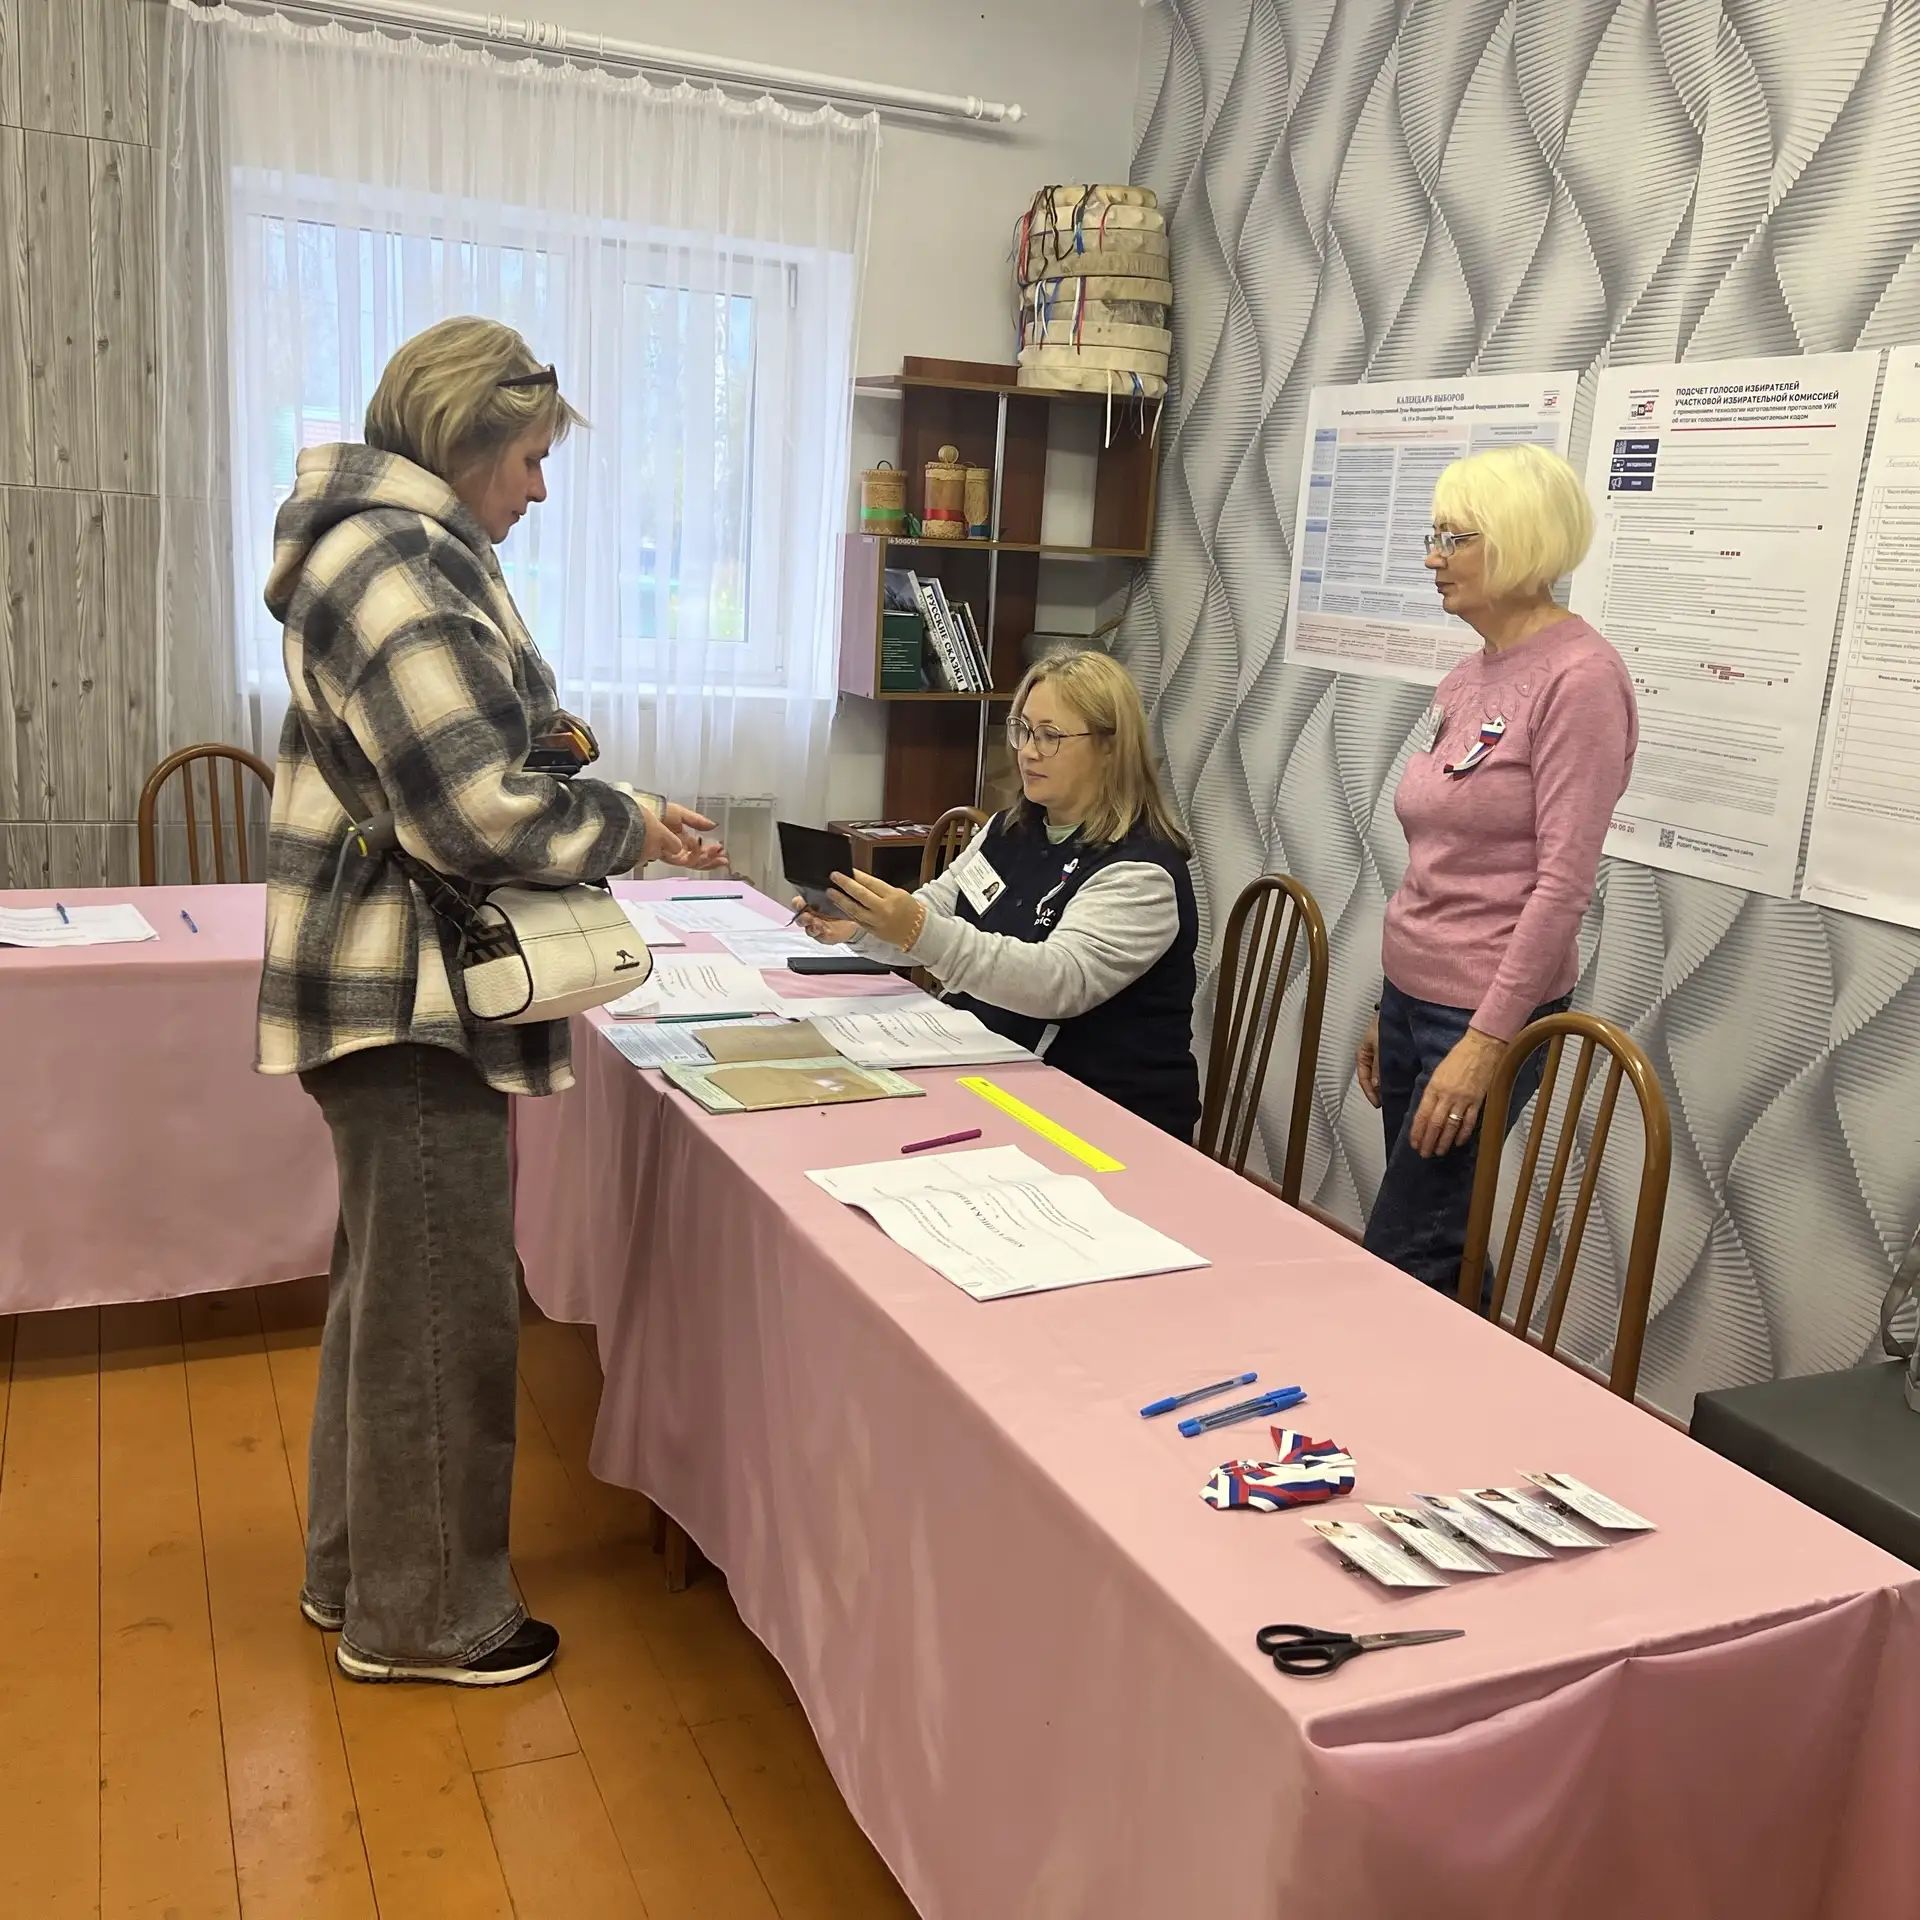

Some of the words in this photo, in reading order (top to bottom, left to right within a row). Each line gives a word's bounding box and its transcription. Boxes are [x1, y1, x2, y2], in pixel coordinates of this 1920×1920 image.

[1676, 387, 1708, 396] ПОДСЧЕТ
[1709, 385, 1743, 394] ГОЛОСОВ
[1745, 380, 1800, 392] ИЗБИРАТЕЛЕЙ
[1397, 395, 1433, 404] КАЛЕНДАРЬ
[1433, 393, 1465, 403] ВЫБОРОВ
[1675, 395, 1722, 406] УЧАСТКОВОЙ
[1723, 392, 1788, 405] ИЗБИРАТЕЛЬНОЙ
[1789, 390, 1839, 402] КОМИССИЕЙ
[1787, 404, 1822, 413] протоколов
[926, 593, 949, 640] РУССКИЕ
[944, 641, 965, 683] СКАЗКИ
